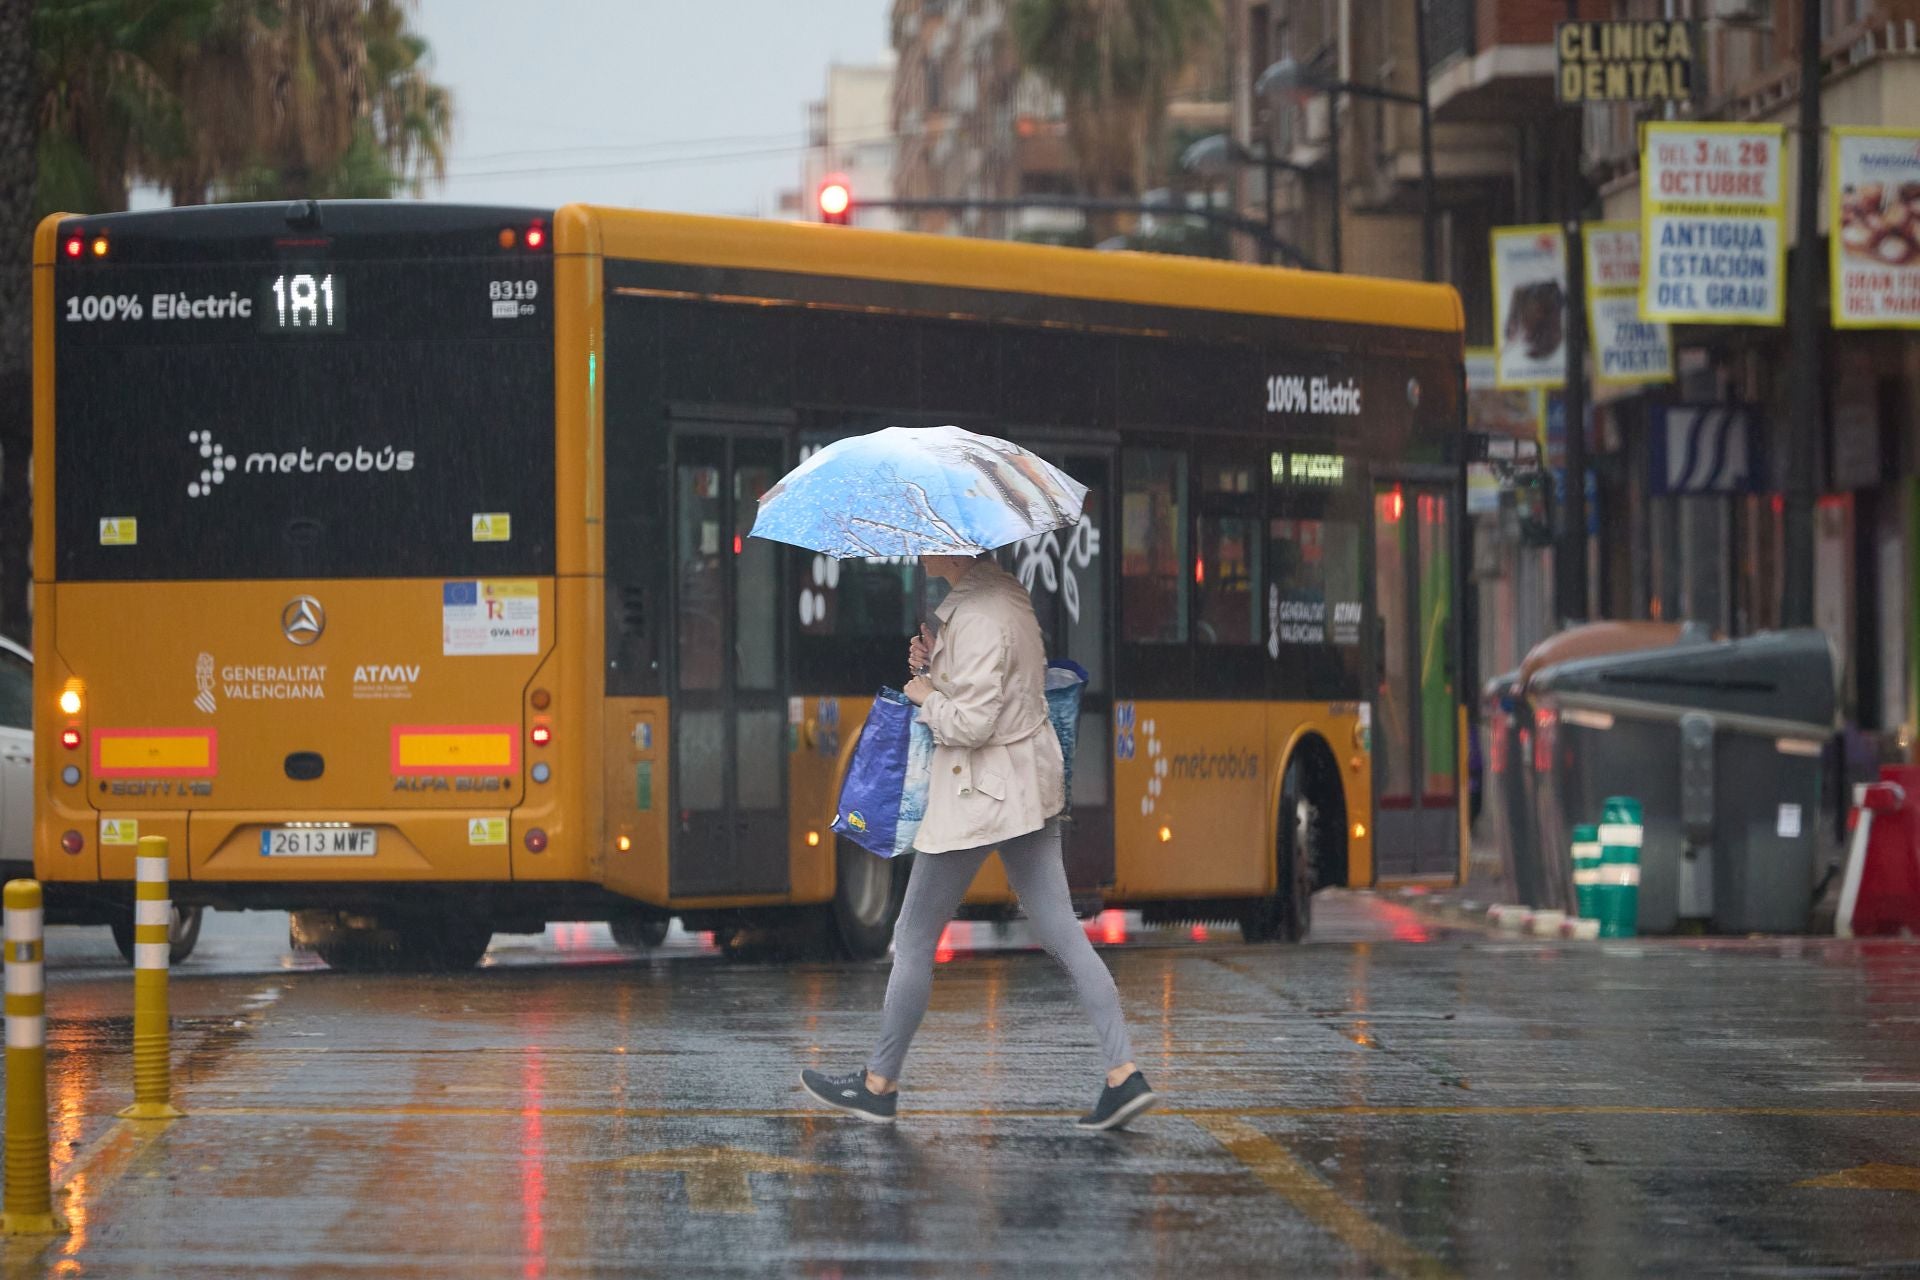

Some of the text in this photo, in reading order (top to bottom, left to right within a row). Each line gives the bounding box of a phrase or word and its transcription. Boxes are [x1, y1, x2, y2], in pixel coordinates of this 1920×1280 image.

[1561, 22, 1692, 60] CLINICA
[1562, 60, 1690, 100] DENTAL
[1695, 139, 1709, 166] 3
[1660, 169, 1766, 198] OCTUBRE
[1661, 222, 1765, 250] ANTIGUA
[272, 274, 334, 327] 181
[489, 280, 538, 300] 8319
[1659, 283, 1768, 311] DEL GRAU
[66, 291, 252, 322] 100% Elèctric
[1266, 374, 1361, 415] 100% Elèctric
[245, 444, 415, 473] metrobús
[222, 665, 327, 682] GENERALITAT
[353, 665, 421, 683] ATMV
[223, 684, 325, 699] VALENCIANA
[275, 831, 372, 853] 2613 MWF
